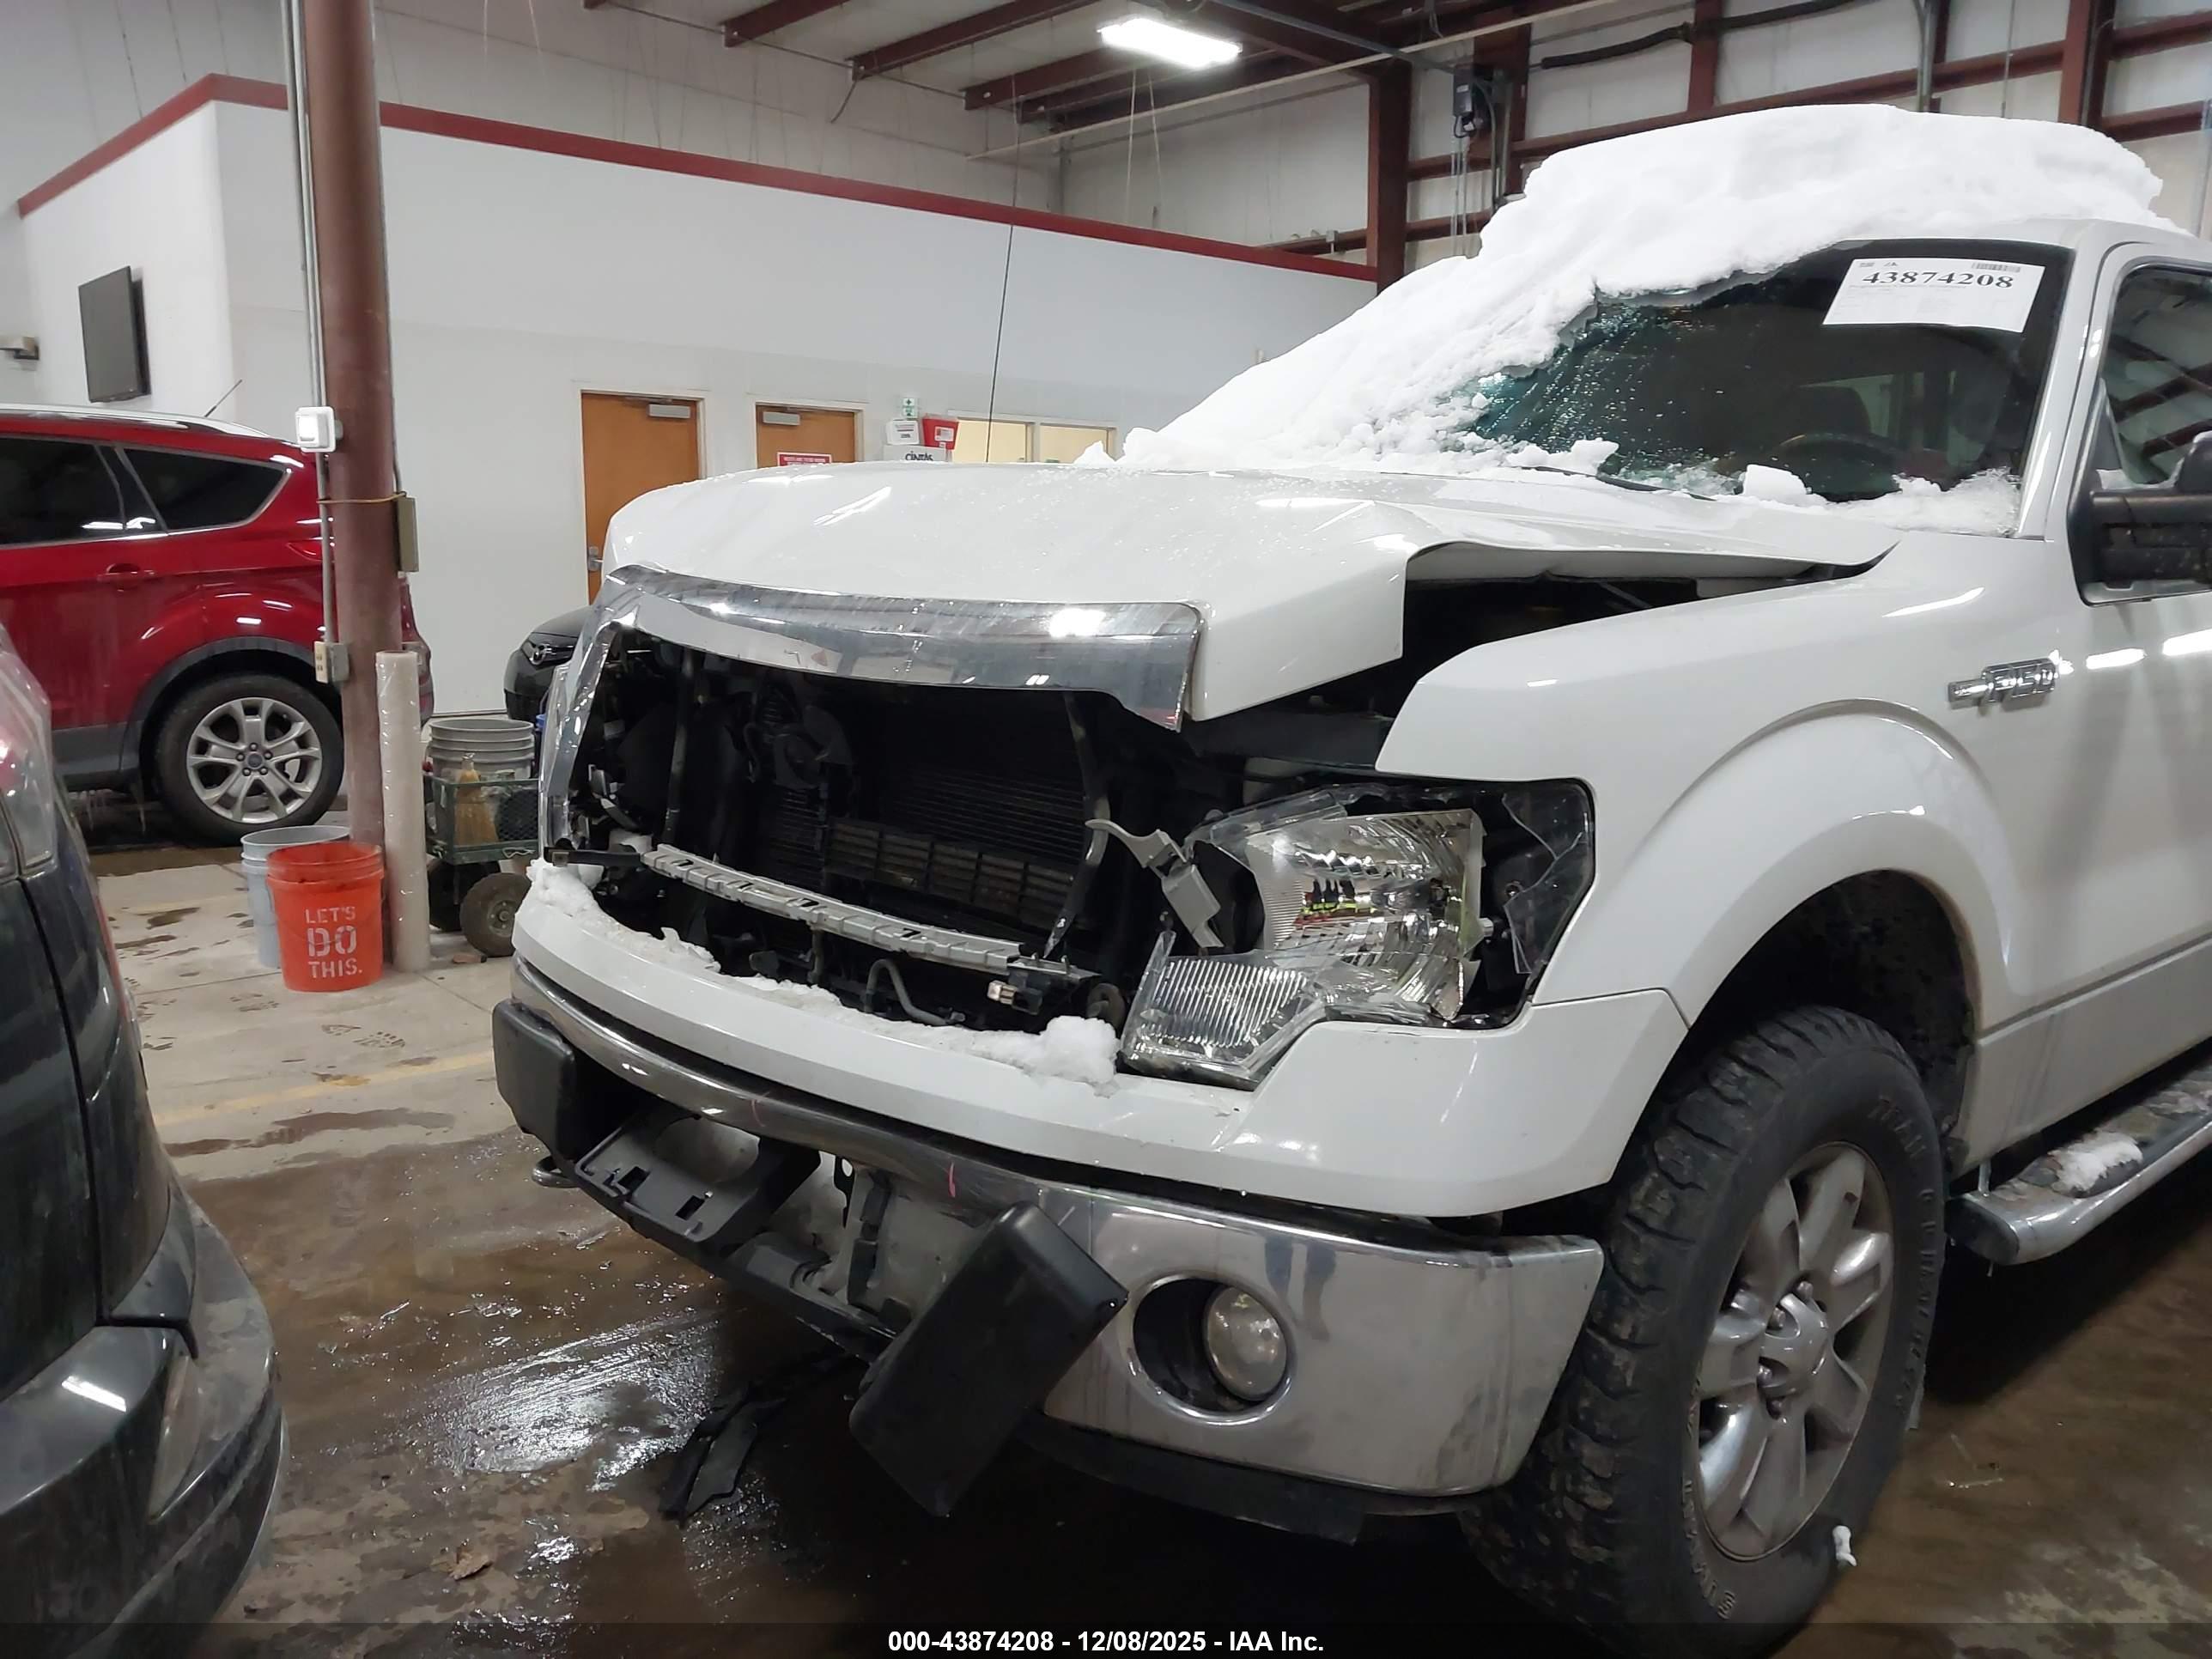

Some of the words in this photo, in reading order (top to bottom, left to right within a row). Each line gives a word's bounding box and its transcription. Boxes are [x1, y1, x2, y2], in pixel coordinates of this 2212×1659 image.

[1862, 271, 2014, 289] 43874208
[305, 906, 356, 924] LET'S
[307, 925, 357, 957] DO
[308, 958, 362, 979] THIS.
